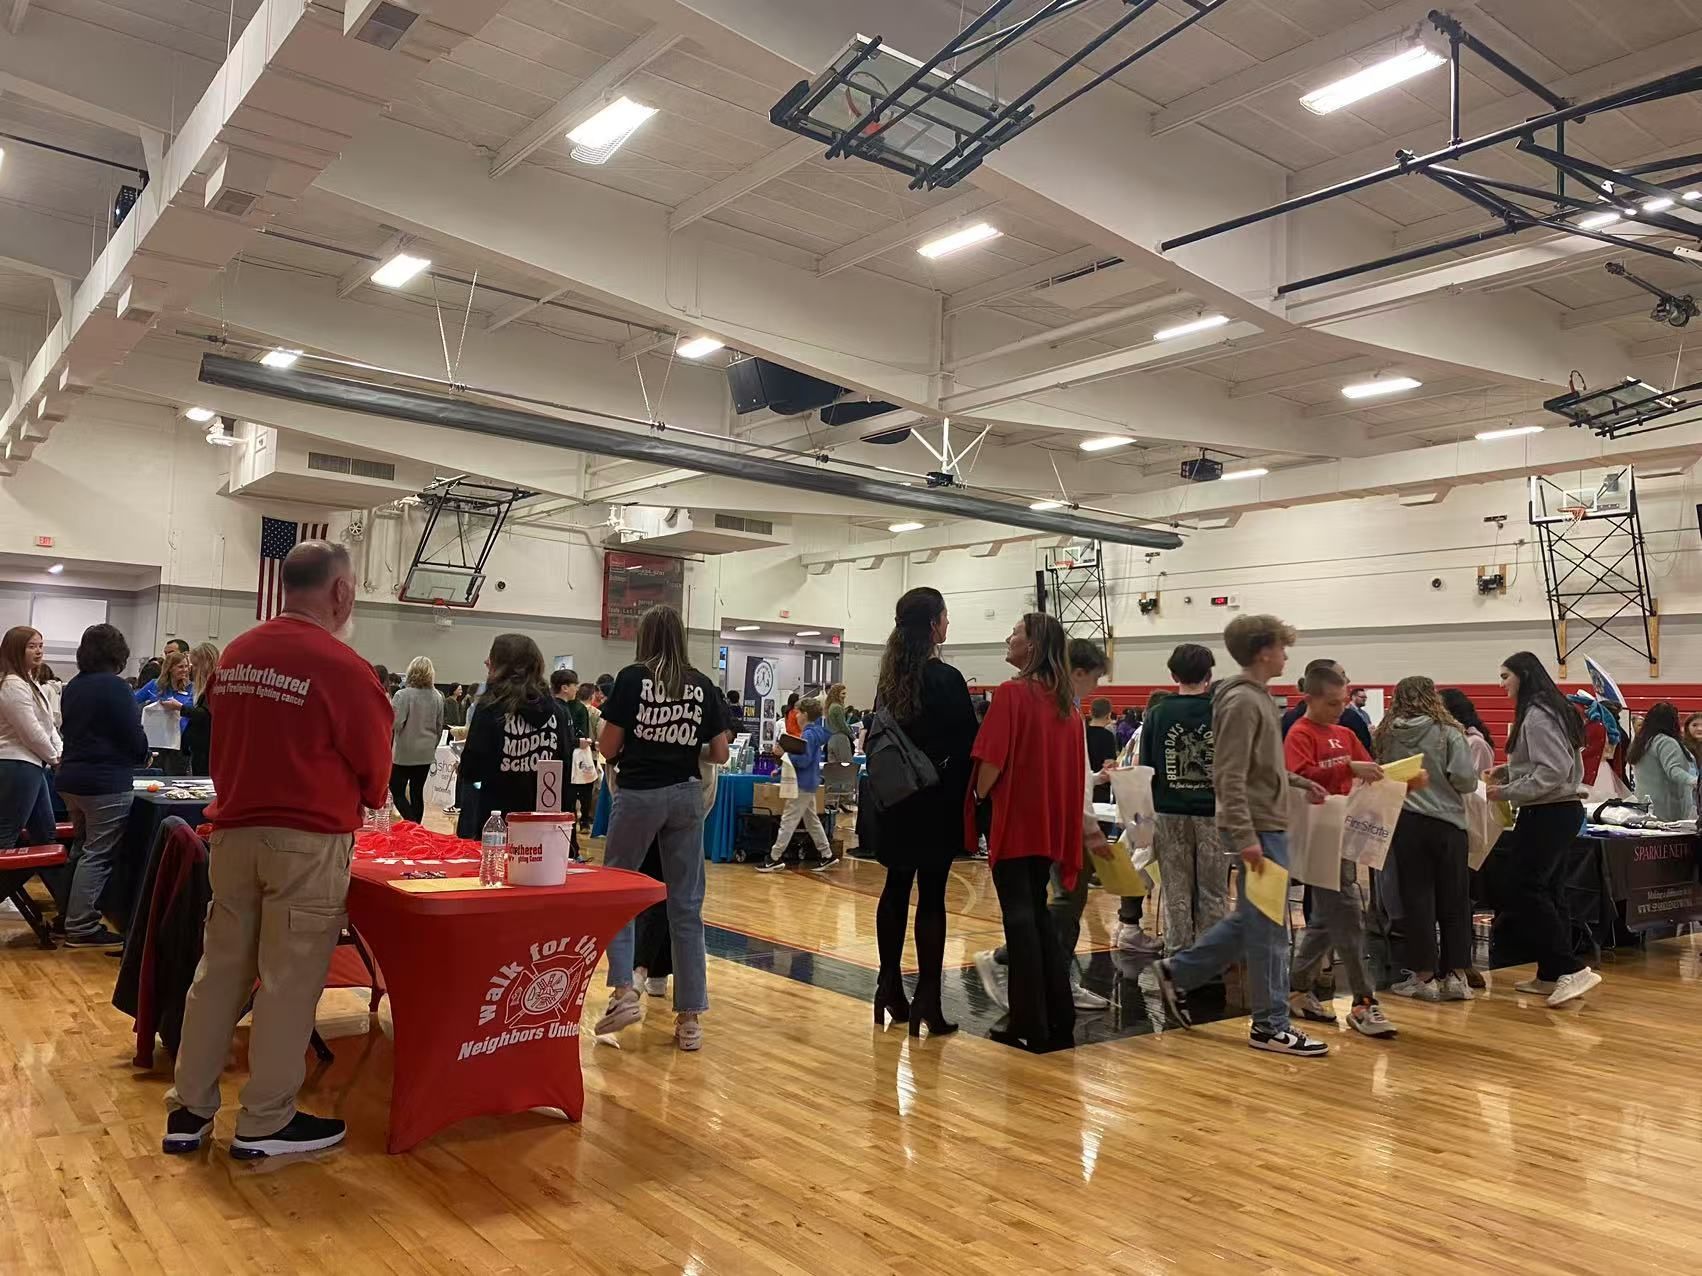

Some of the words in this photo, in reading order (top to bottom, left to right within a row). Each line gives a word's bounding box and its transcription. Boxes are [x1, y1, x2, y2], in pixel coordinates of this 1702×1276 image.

[281, 693, 305, 707] cancer
[640, 678, 704, 704] ROEO
[504, 713, 558, 736] ROO
[636, 703, 703, 726] MIDDLE
[502, 731, 558, 757] MIDDLE
[633, 722, 698, 746] SCHOOL
[1164, 723, 1184, 746] DAYS
[1328, 739, 1344, 749] R
[1165, 748, 1177, 780] BETTER
[541, 771, 557, 808] 8
[1633, 844, 1668, 861] SPARKLE
[478, 961, 525, 1026] walk
[529, 936, 571, 962] for
[574, 935, 597, 965] the
[457, 1027, 545, 1061] Neighbors
